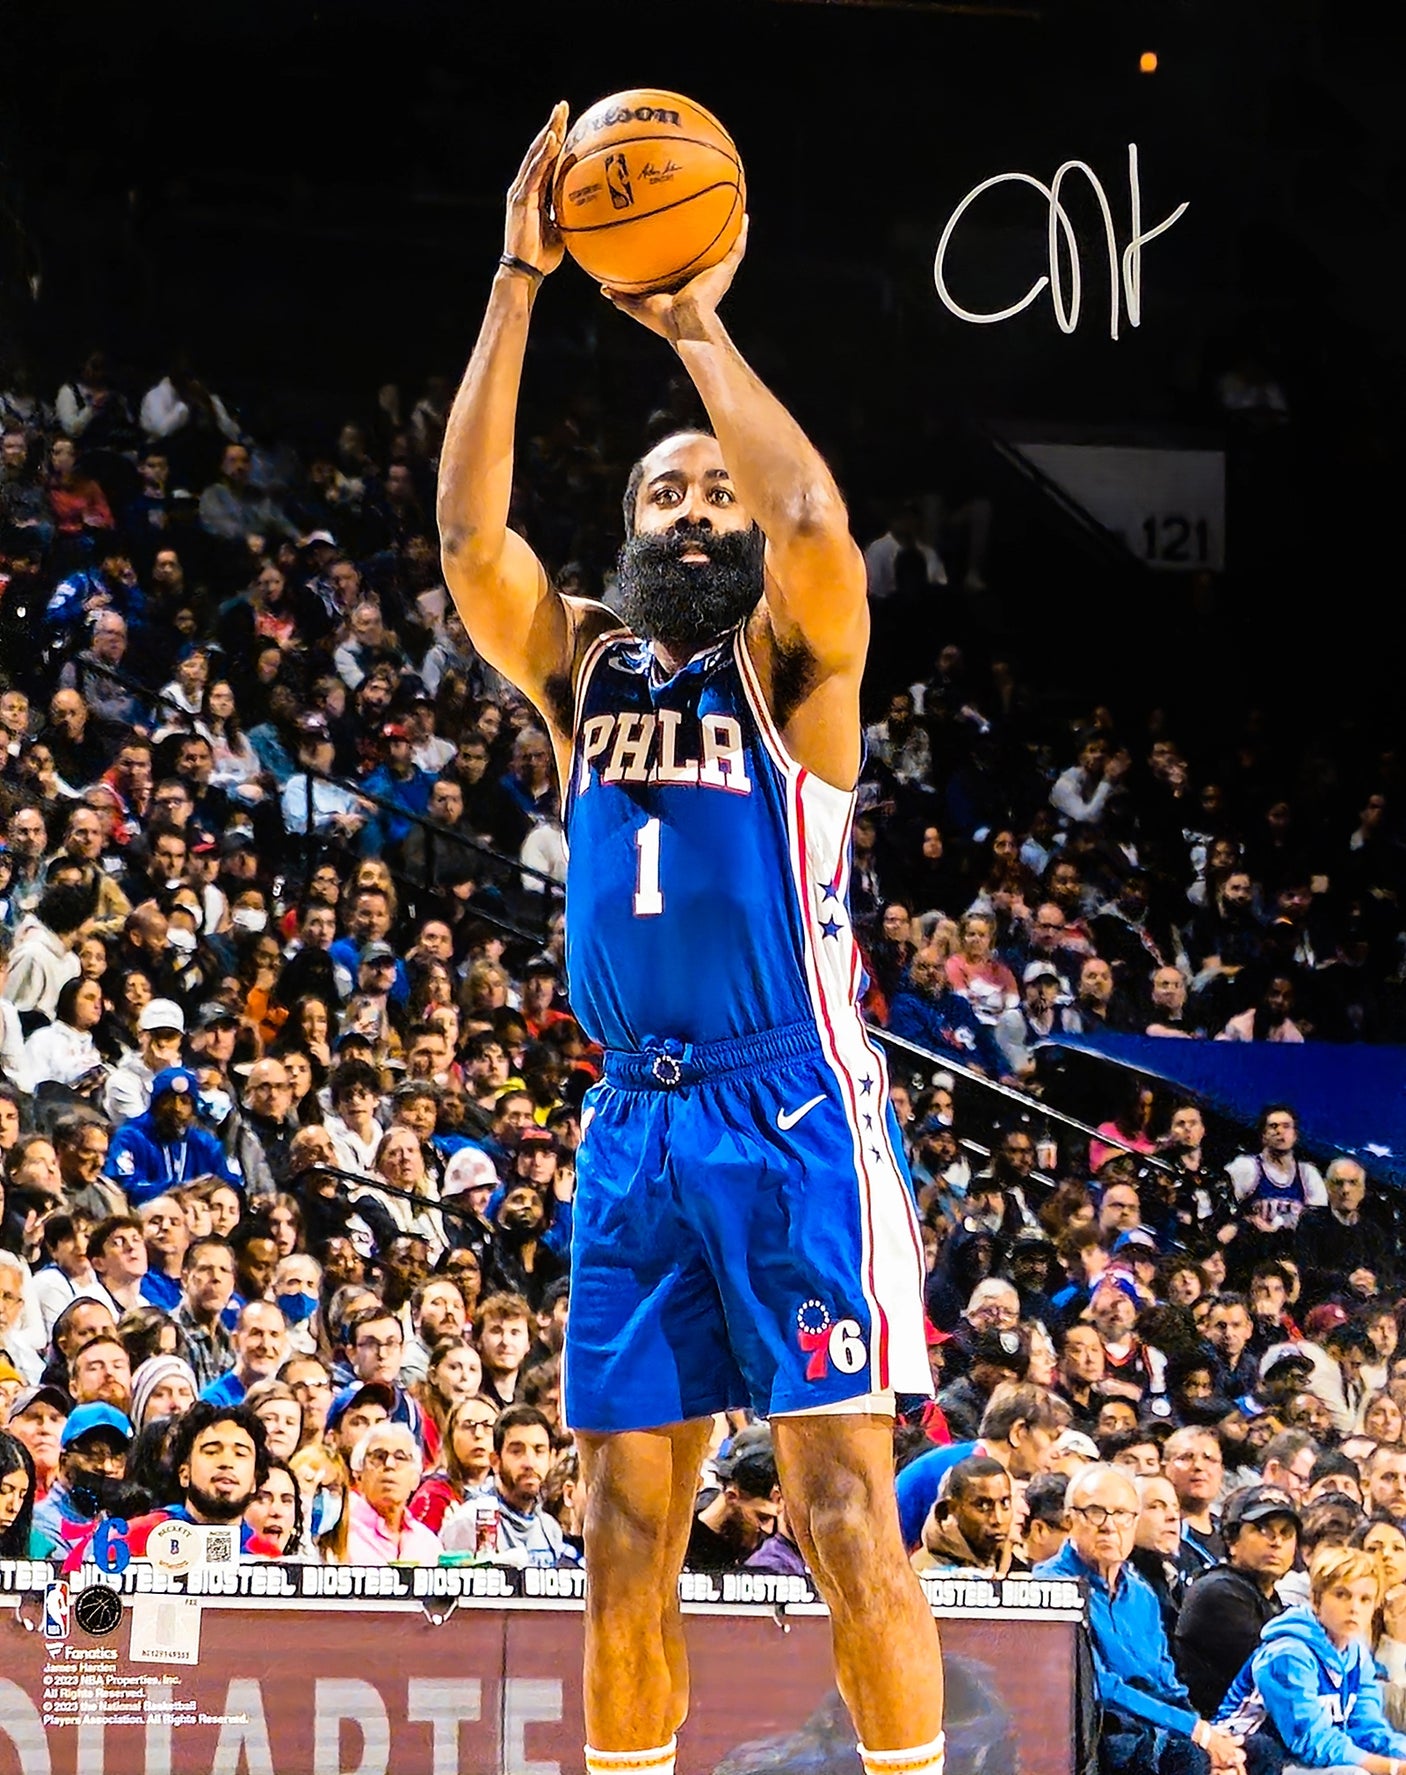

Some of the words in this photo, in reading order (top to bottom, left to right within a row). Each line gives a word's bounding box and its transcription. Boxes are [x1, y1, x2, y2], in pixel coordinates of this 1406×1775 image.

[1143, 515, 1208, 562] 121
[633, 817, 664, 916] 1
[187, 1565, 297, 1597] BIOSTEEL
[302, 1566, 411, 1597] BIOSTEEL
[413, 1567, 515, 1597] BIOSTEEL
[525, 1567, 587, 1597] BIOST
[723, 1573, 815, 1603] BIOSTEEL
[1001, 1580, 1085, 1609] BIOSTEEL
